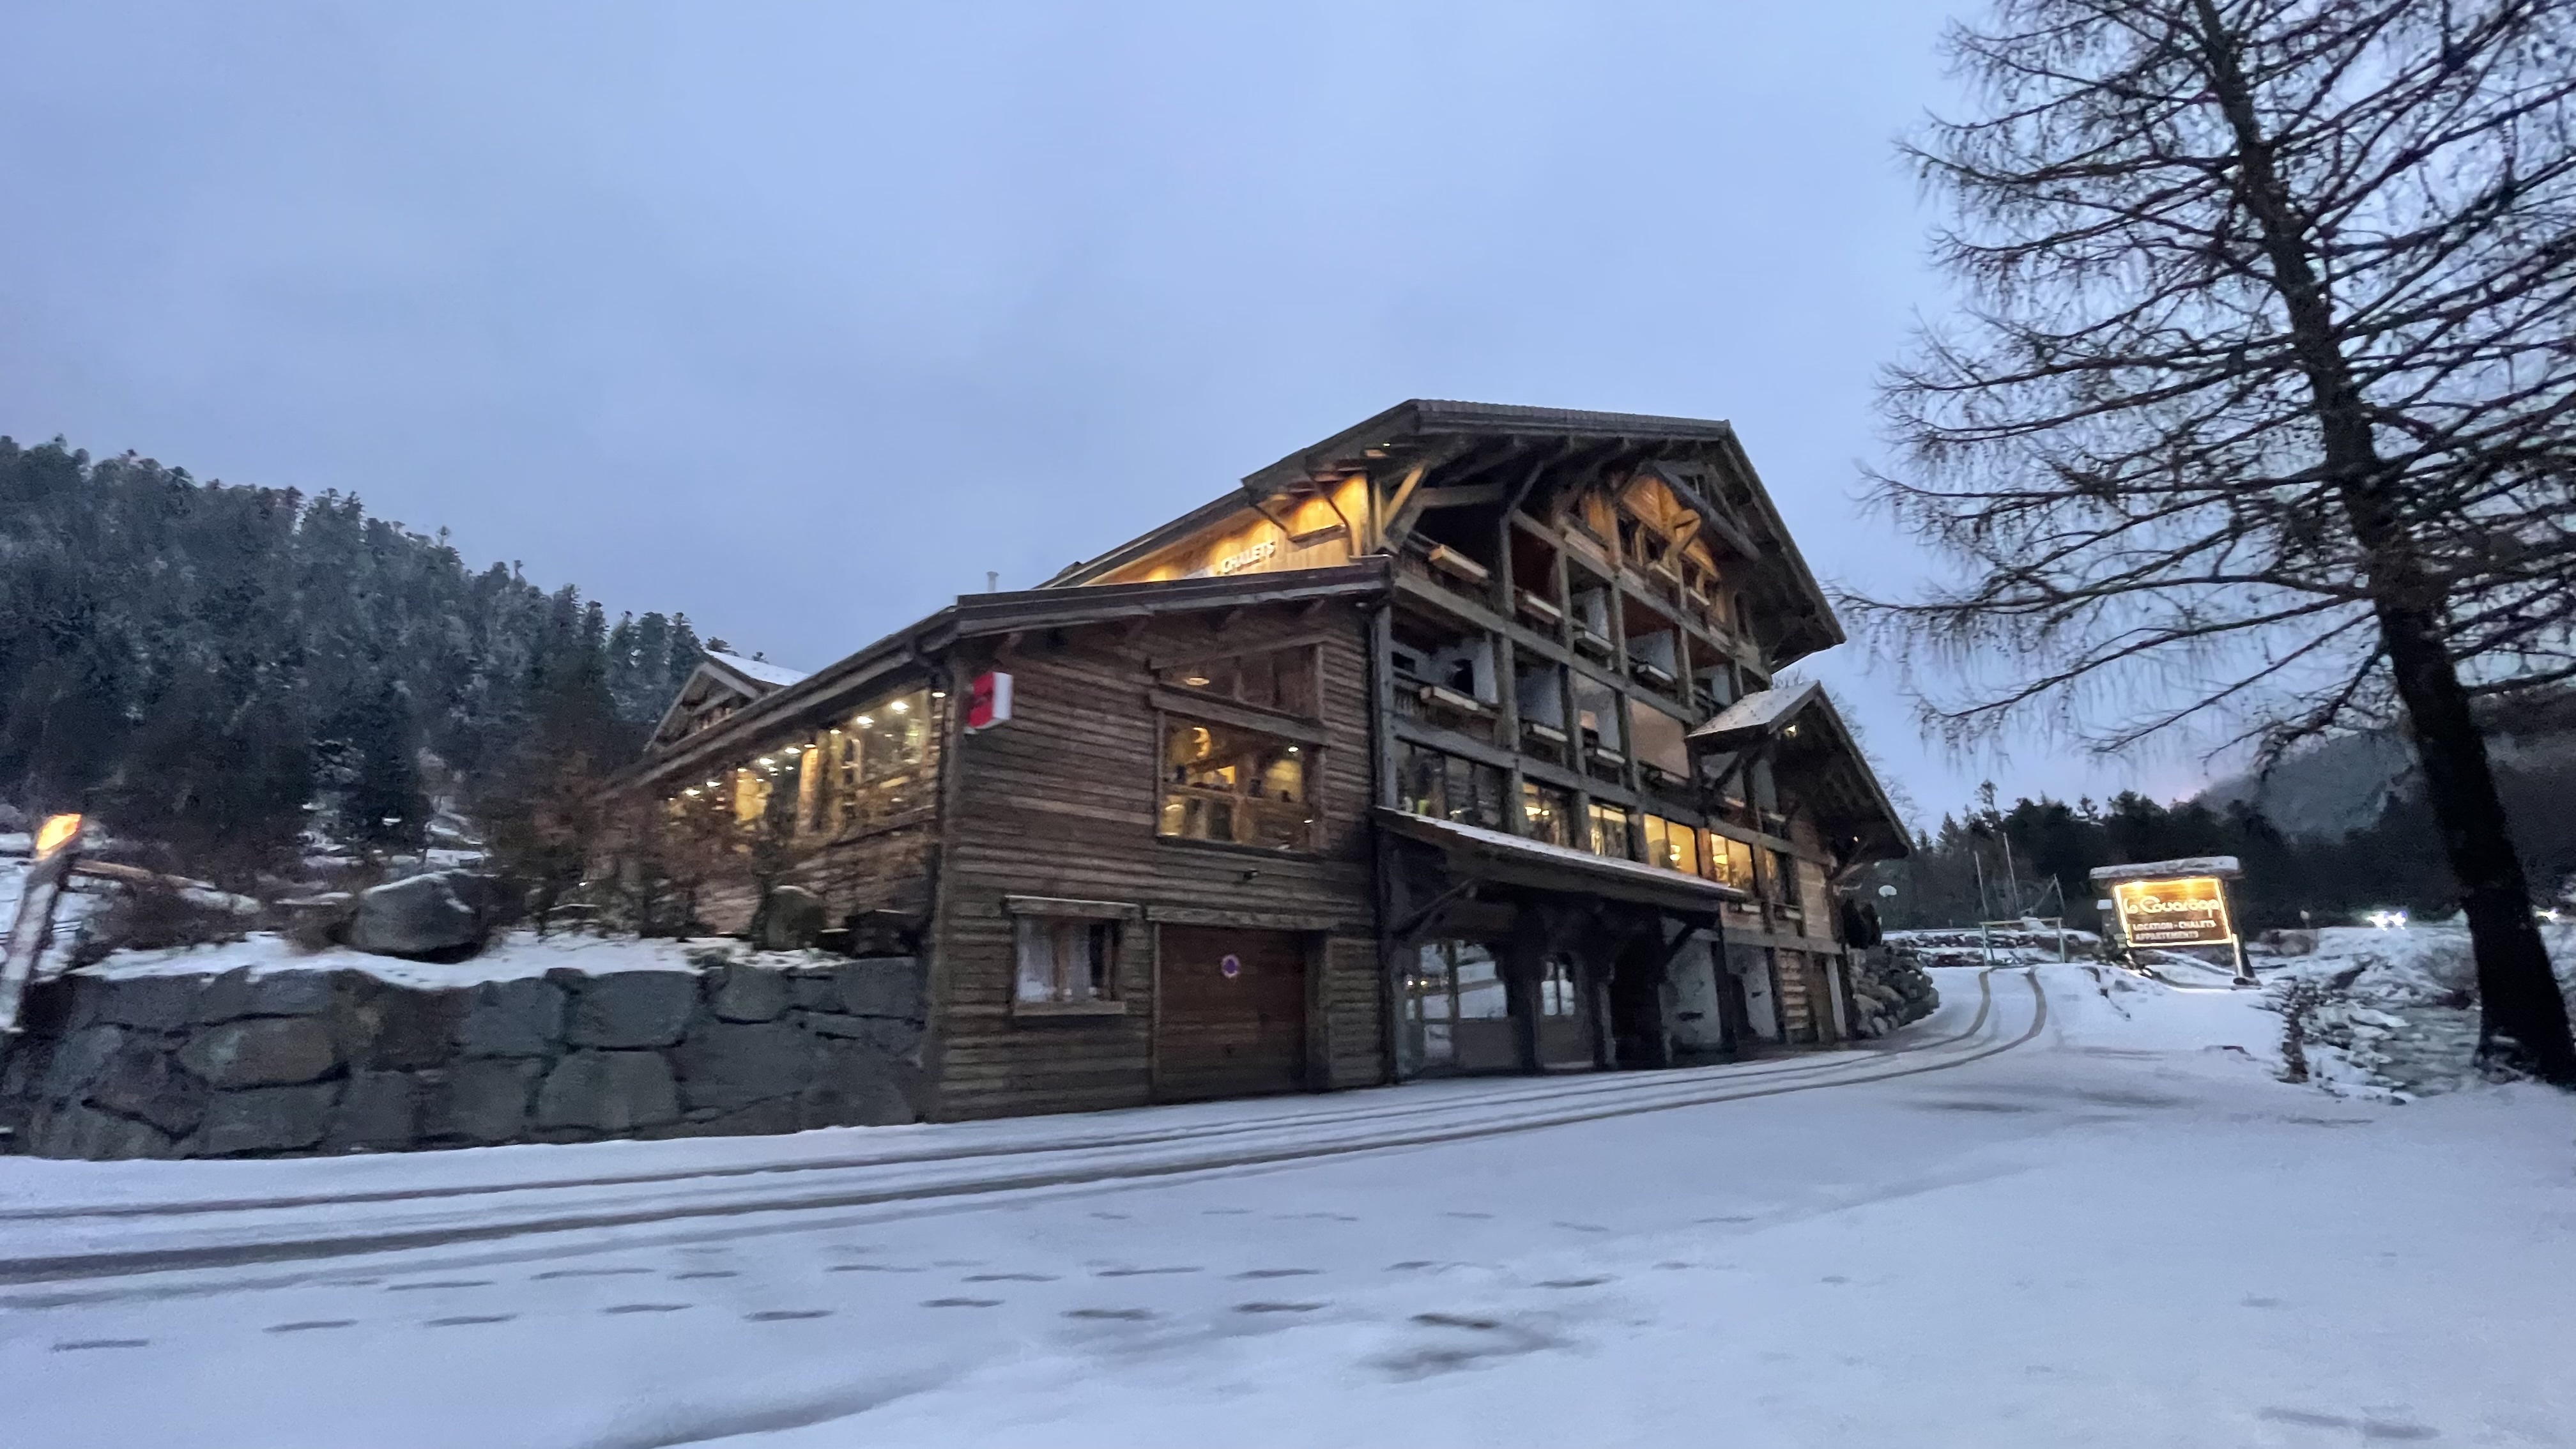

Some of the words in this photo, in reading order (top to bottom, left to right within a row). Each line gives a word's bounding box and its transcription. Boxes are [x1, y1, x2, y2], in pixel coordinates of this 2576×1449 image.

[1221, 542, 1276, 573] CHALETS
[2133, 922, 2173, 931] LOCATION
[2136, 930, 2199, 940] APPARTEMENTS
